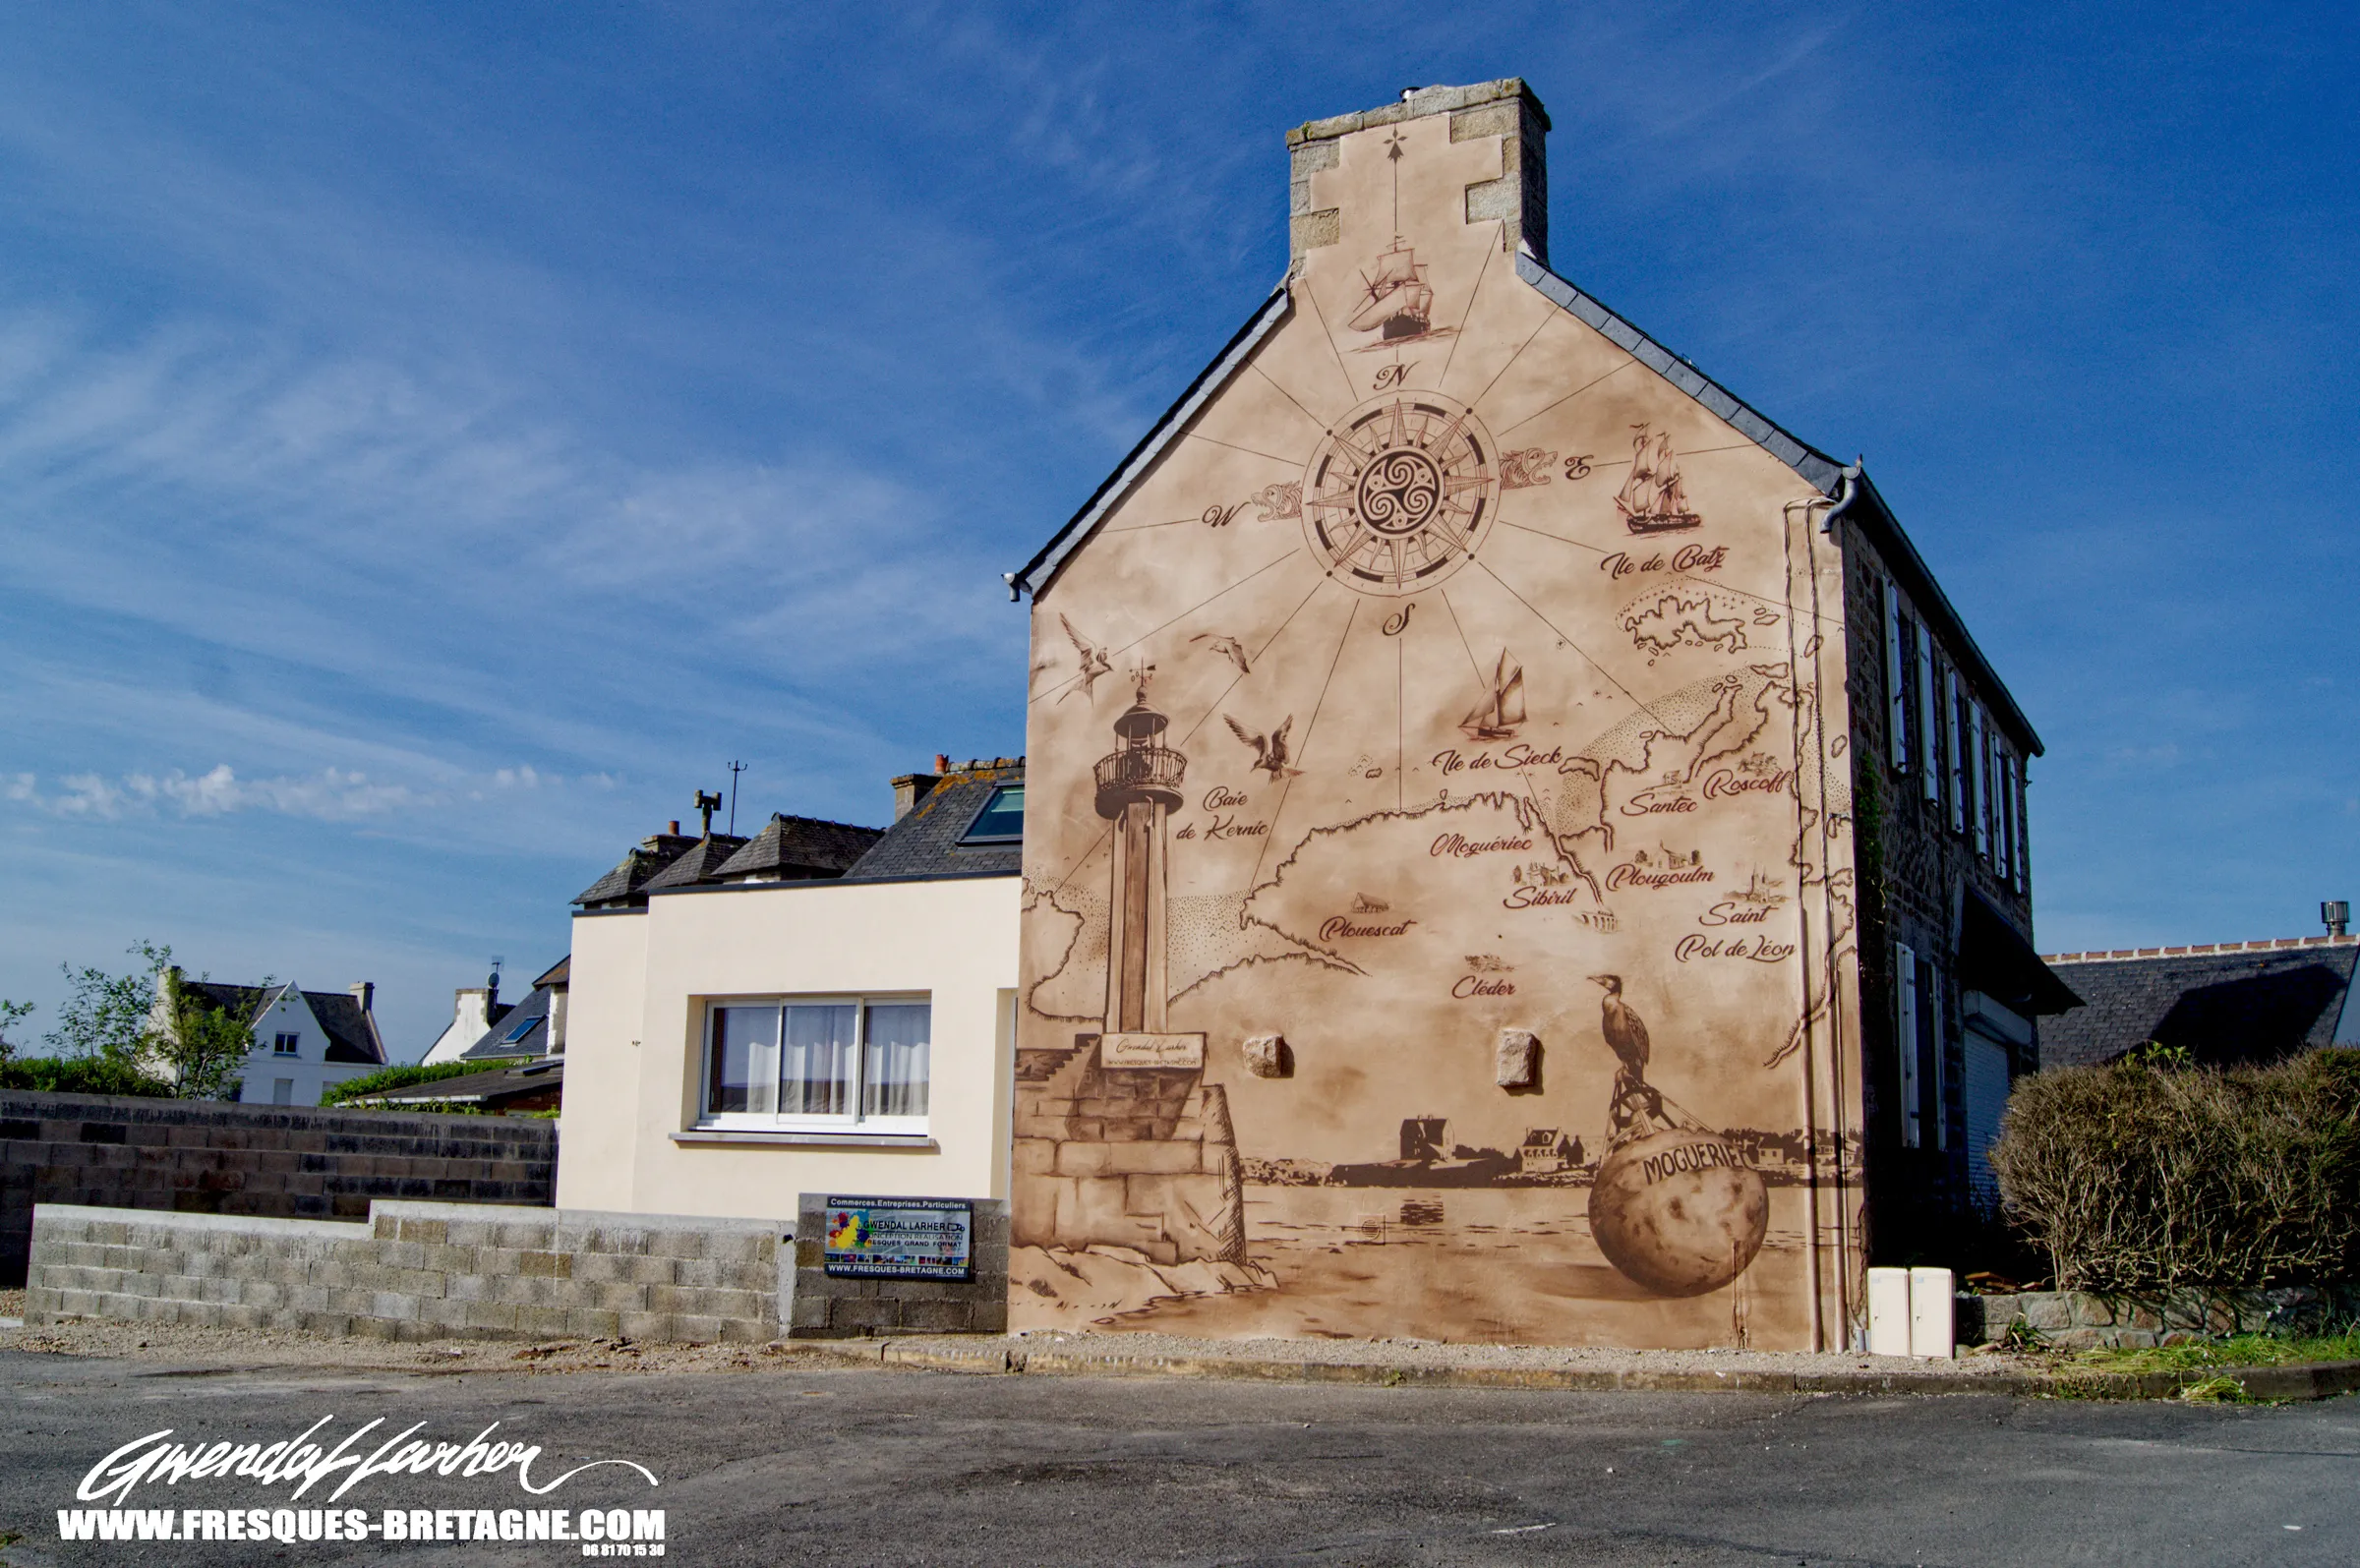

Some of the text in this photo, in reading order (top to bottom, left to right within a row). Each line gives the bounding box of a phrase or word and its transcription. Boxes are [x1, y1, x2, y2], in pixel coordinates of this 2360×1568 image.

[1374, 360, 1421, 391] N
[1640, 550, 1666, 573] de
[1673, 545, 1730, 572] Batz
[1383, 603, 1418, 637] S
[1469, 750, 1493, 771] de
[1494, 744, 1563, 771] Sieck
[1703, 768, 1789, 799] Roscoff
[1203, 785, 1248, 812] Baie
[1621, 792, 1699, 816] Santec
[1176, 815, 1268, 841] de Kernic
[1431, 834, 1533, 858] Moguériec
[1606, 863, 1716, 891] Plougoulm
[1503, 887, 1576, 910] Sibiril
[1698, 902, 1777, 927] Saint
[1320, 916, 1417, 942] Plouescat
[1675, 935, 1796, 962] Pol de Léon
[1451, 976, 1516, 1000] Cléder
[863, 1221, 907, 1230] GWENDAL
[828, 1264, 965, 1275] WWW.FRESQUES-BRETAGNE.COM
